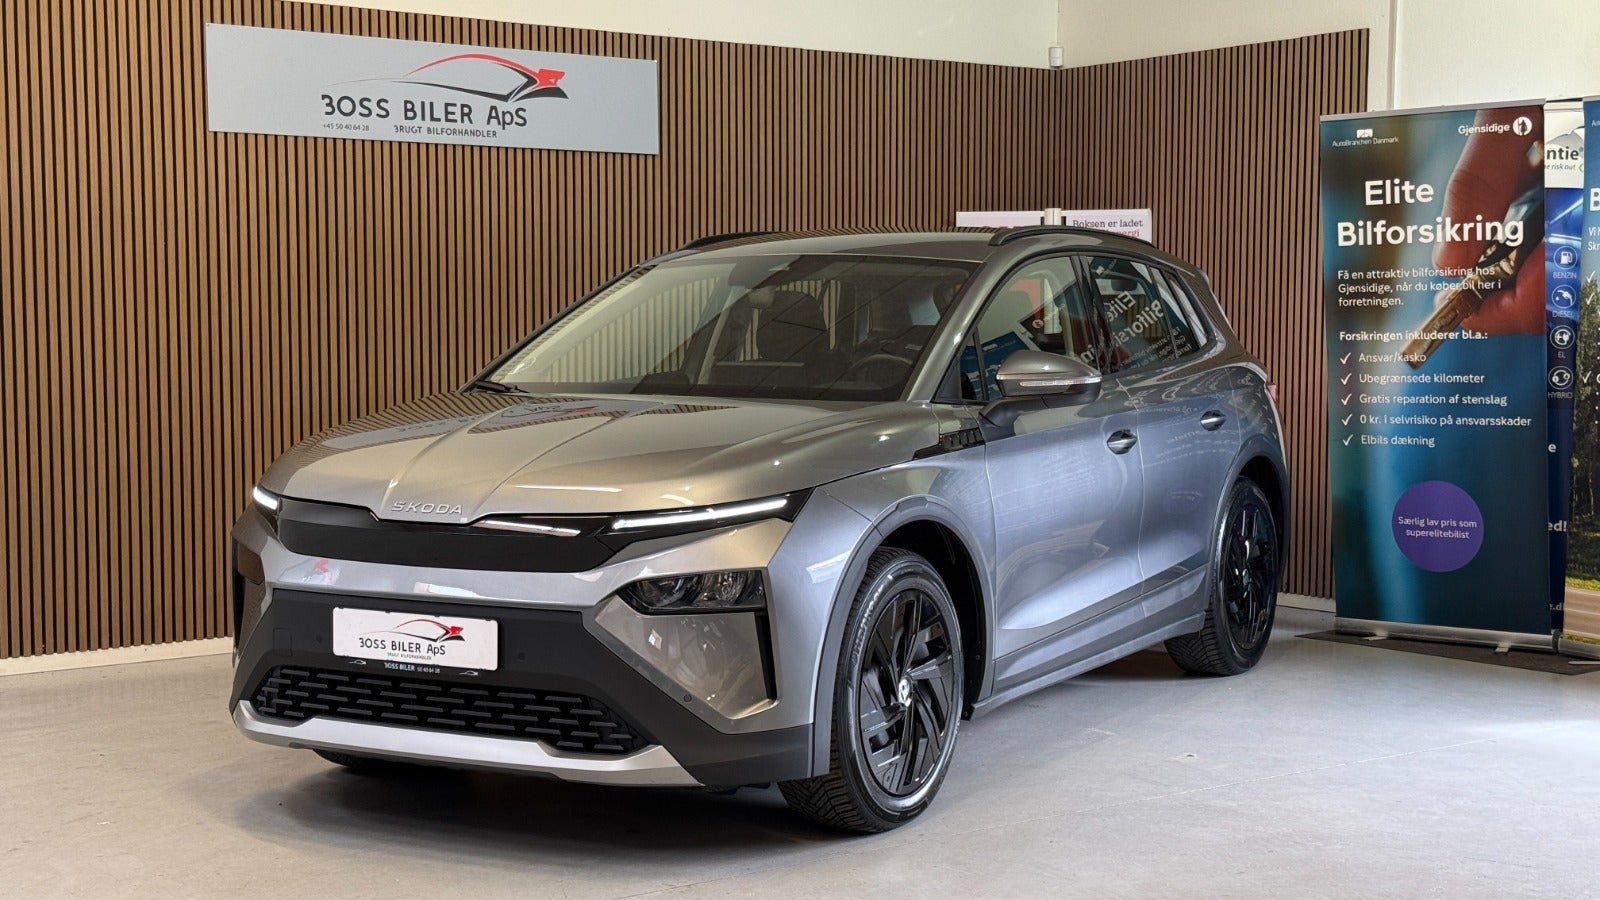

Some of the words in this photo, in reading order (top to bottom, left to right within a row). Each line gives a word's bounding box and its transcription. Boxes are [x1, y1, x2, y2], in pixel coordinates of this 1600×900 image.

[403, 100, 474, 124] BILER
[486, 105, 528, 130] ApS
[362, 124, 370, 132] 28
[427, 127, 498, 138] BILFORHANDLER
[1457, 123, 1510, 136] Gjensidige
[1332, 137, 1372, 147] AutoBranchen
[1373, 136, 1399, 145] Danmark
[1546, 146, 1579, 160] ntie
[1365, 178, 1434, 206] Elite
[1590, 187, 1600, 211] B
[1072, 219, 1106, 229] Boksen
[1119, 219, 1143, 228] ladet
[1337, 214, 1524, 247] Bilforsikring
[1338, 269, 1350, 280] Få
[1351, 271, 1364, 280] en
[1366, 268, 1410, 279] attraktiv
[1412, 266, 1473, 279] bilforsikring
[1475, 266, 1495, 276] hos
[1553, 271, 1577, 280] BENZIN
[1338, 283, 1393, 294] Gjensidige,
[1395, 281, 1413, 291] når
[1414, 281, 1428, 291] du
[1429, 280, 1461, 291] køber
[1462, 280, 1475, 291] bil
[1477, 280, 1496, 290] her
[1338, 297, 1404, 309] forretningen.
[1552, 310, 1574, 318] DIESEL
[1340, 331, 1403, 343] Forsikringen
[1405, 331, 1460, 341] inkluderer
[1462, 330, 1488, 340] bl.a.:
[1358, 352, 1427, 363] Ansvar/kasko
[1359, 373, 1431, 386] Ubegrænsede
[1433, 373, 1485, 384] kilometer
[1359, 394, 1390, 405] Gratis
[1392, 395, 1446, 407] reparation
[1448, 394, 1460, 405] af
[1461, 394, 1508, 407] stenslag
[1548, 391, 1573, 399] HYBRID
[1369, 414, 1382, 425] kr.
[1389, 414, 1437, 425] selvrisiko
[1439, 414, 1454, 428] på
[1455, 415, 1532, 427] ansvarsskader
[1361, 434, 1388, 445] Elbils
[1390, 434, 1436, 447] dækning
[1398, 516, 1425, 527] Særlig
[1426, 517, 1439, 527] lav
[1441, 518, 1457, 529] pris
[1459, 520, 1477, 528] som
[1406, 529, 1470, 539] superelitebilist
[391, 641, 421, 653] BILER
[427, 644, 446, 656] ApS
[400, 663, 415, 671] BILER
